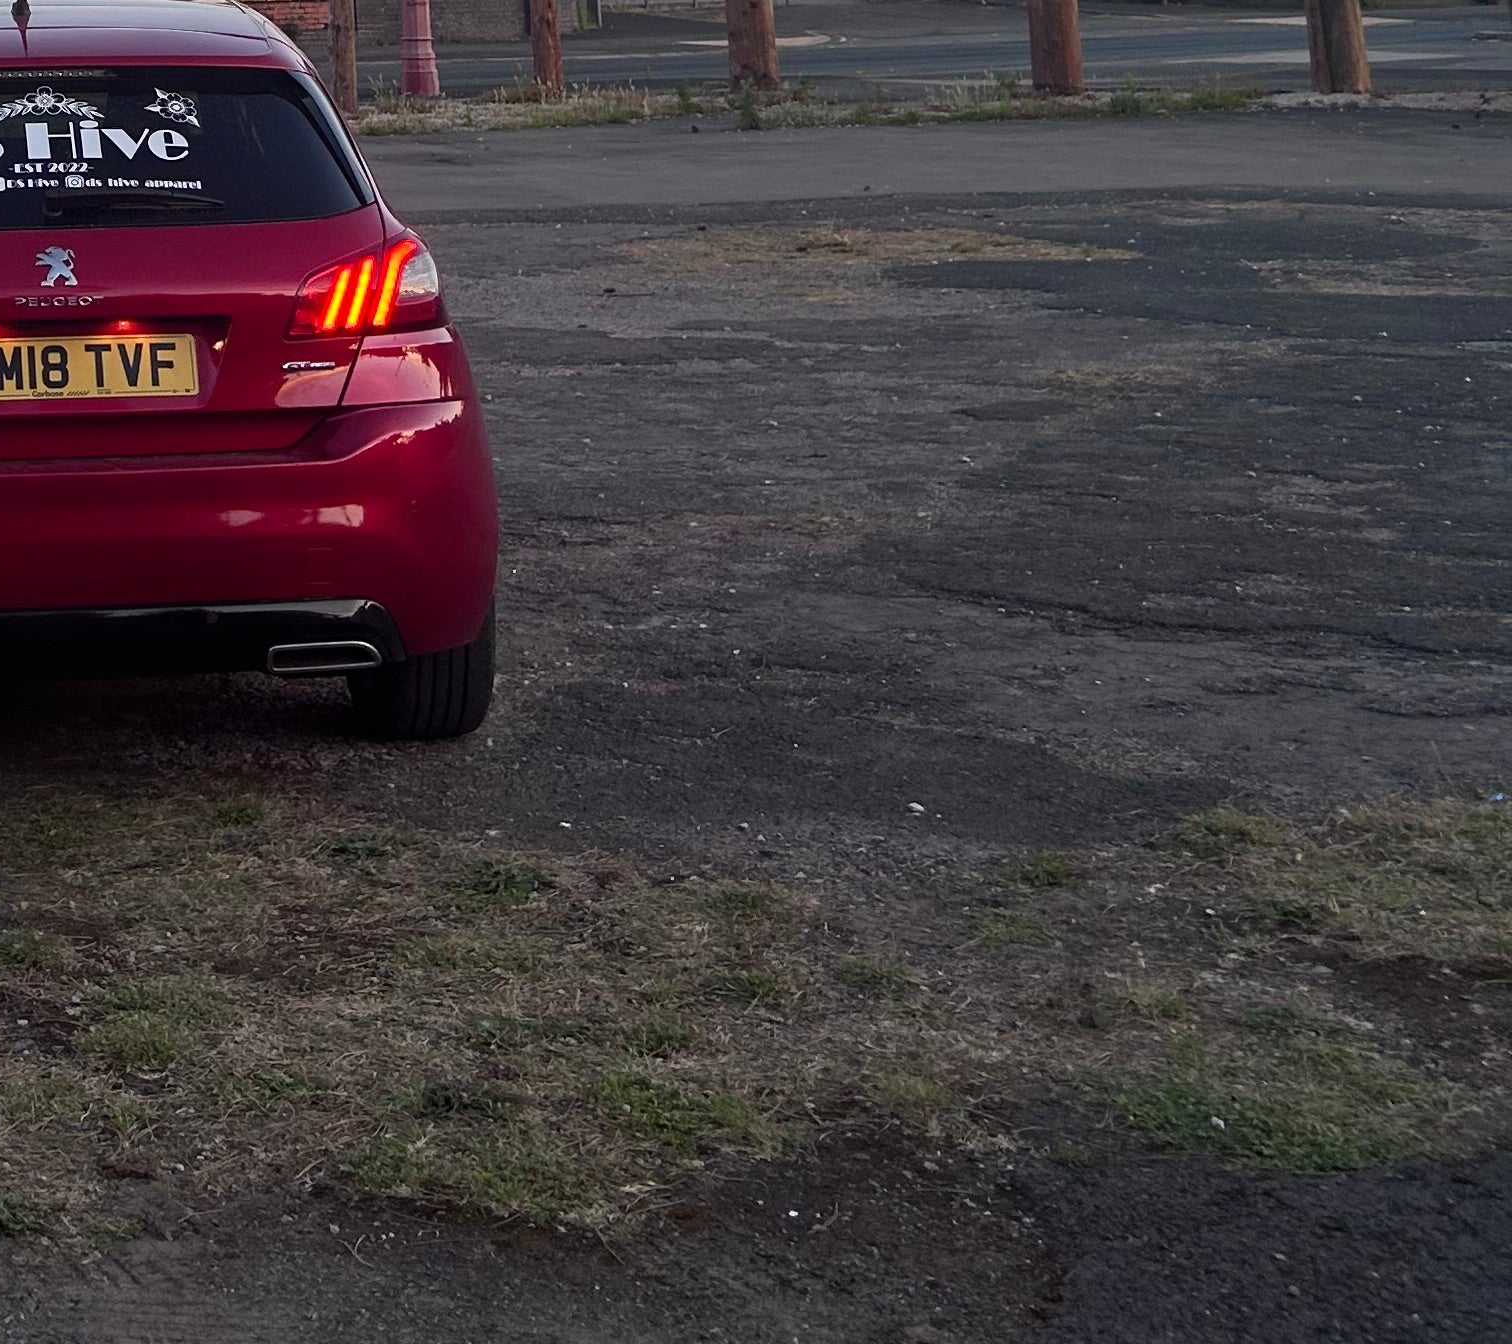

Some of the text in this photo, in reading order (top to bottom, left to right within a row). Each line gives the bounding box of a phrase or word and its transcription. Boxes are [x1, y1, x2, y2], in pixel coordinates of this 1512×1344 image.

[25, 120, 189, 161] Hive
[14, 295, 105, 307] PEUGEOT
[84, 343, 177, 388] TVF
